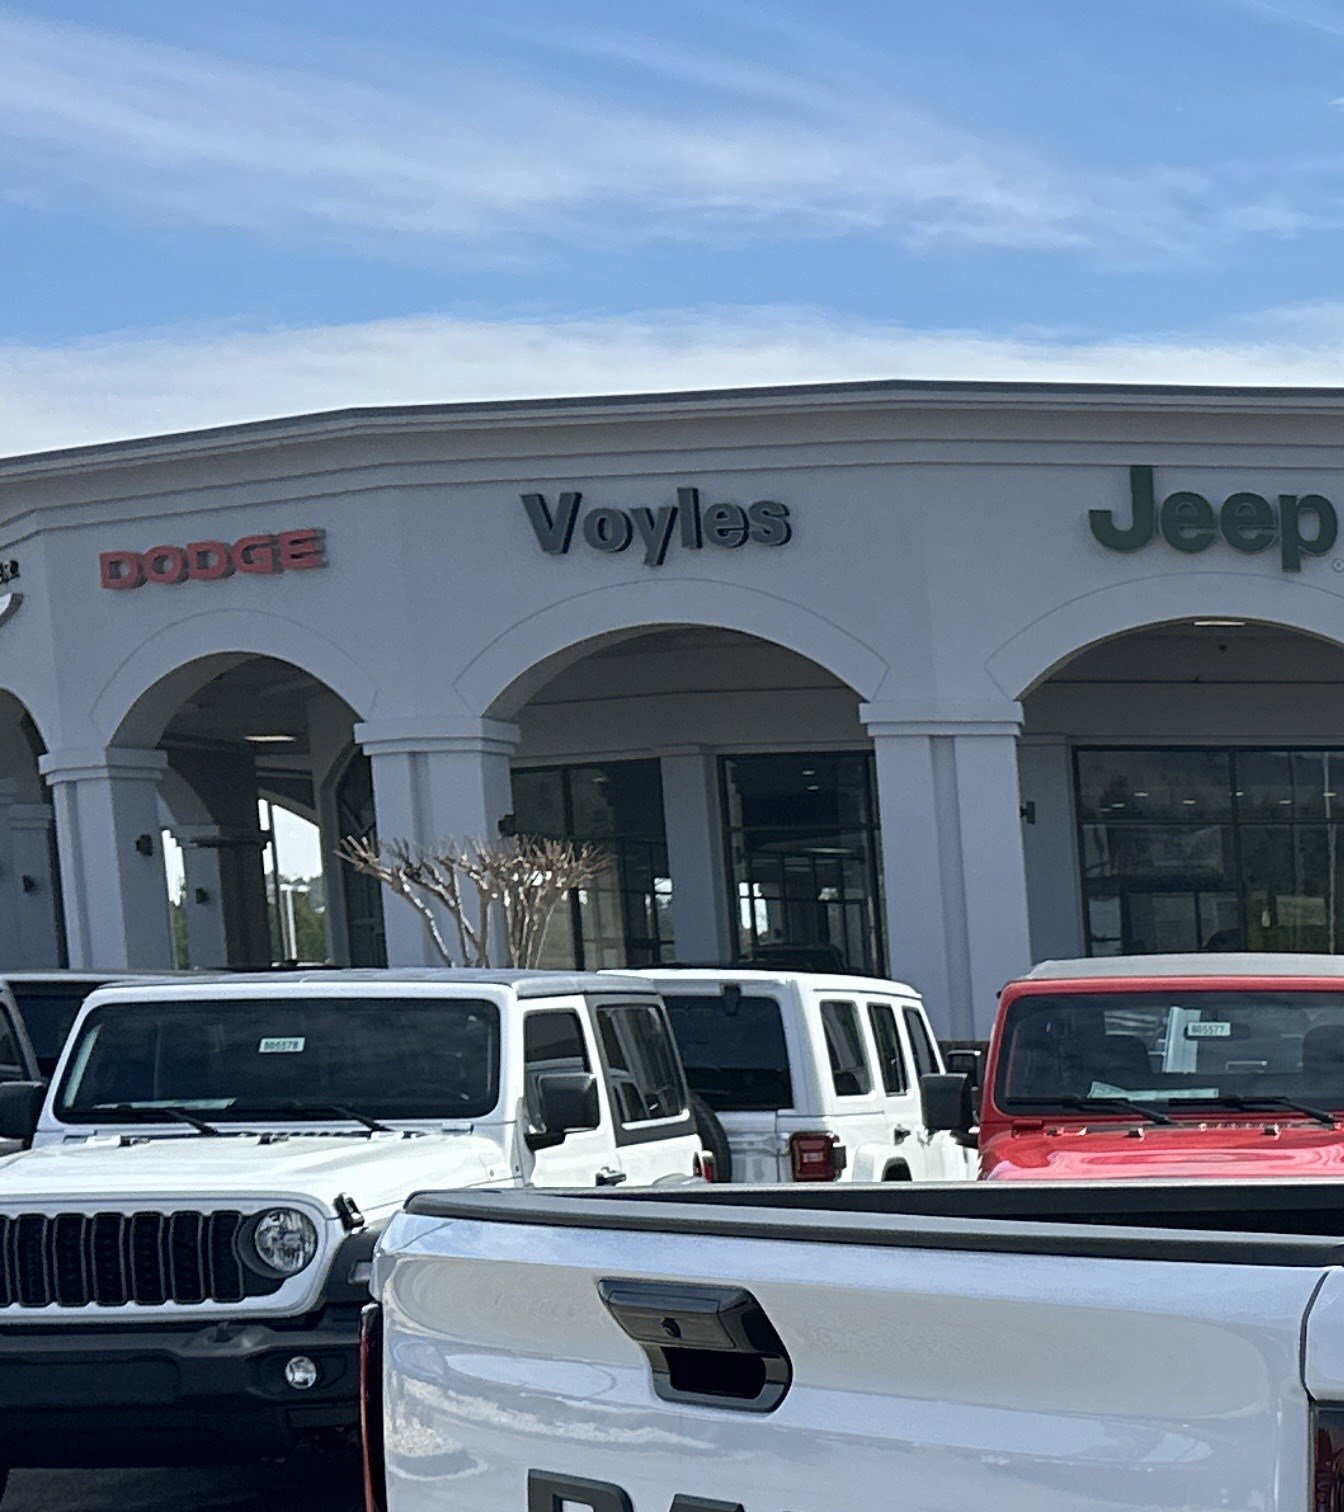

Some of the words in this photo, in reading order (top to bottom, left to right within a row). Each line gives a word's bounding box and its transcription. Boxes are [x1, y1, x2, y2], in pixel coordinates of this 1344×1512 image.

[520, 486, 793, 566] Voyles
[1088, 464, 1339, 572] Jeep
[99, 528, 330, 590] DODGE
